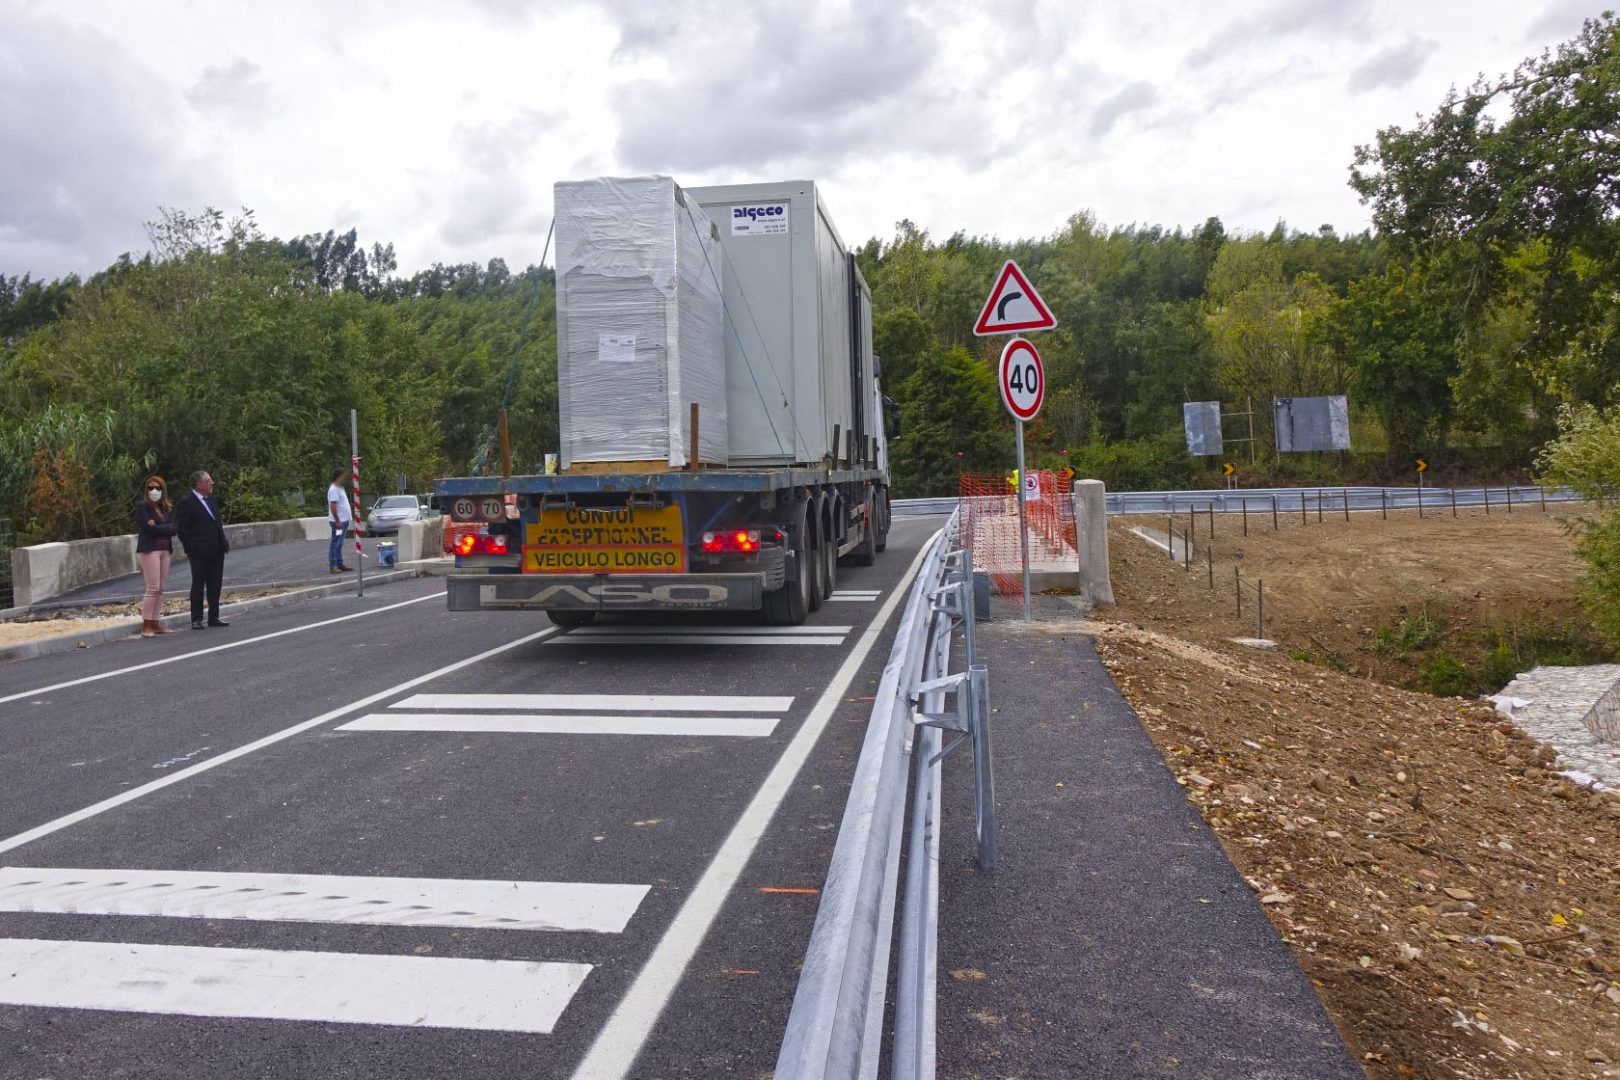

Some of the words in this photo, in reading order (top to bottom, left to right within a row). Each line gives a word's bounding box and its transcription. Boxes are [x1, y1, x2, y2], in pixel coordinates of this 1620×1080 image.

[1010, 364, 1038, 394] 40
[457, 502, 473, 515] 60
[484, 502, 500, 515] 70
[535, 552, 609, 567] VEICULO
[615, 551, 676, 566] LONGO
[480, 584, 729, 603] LASO
